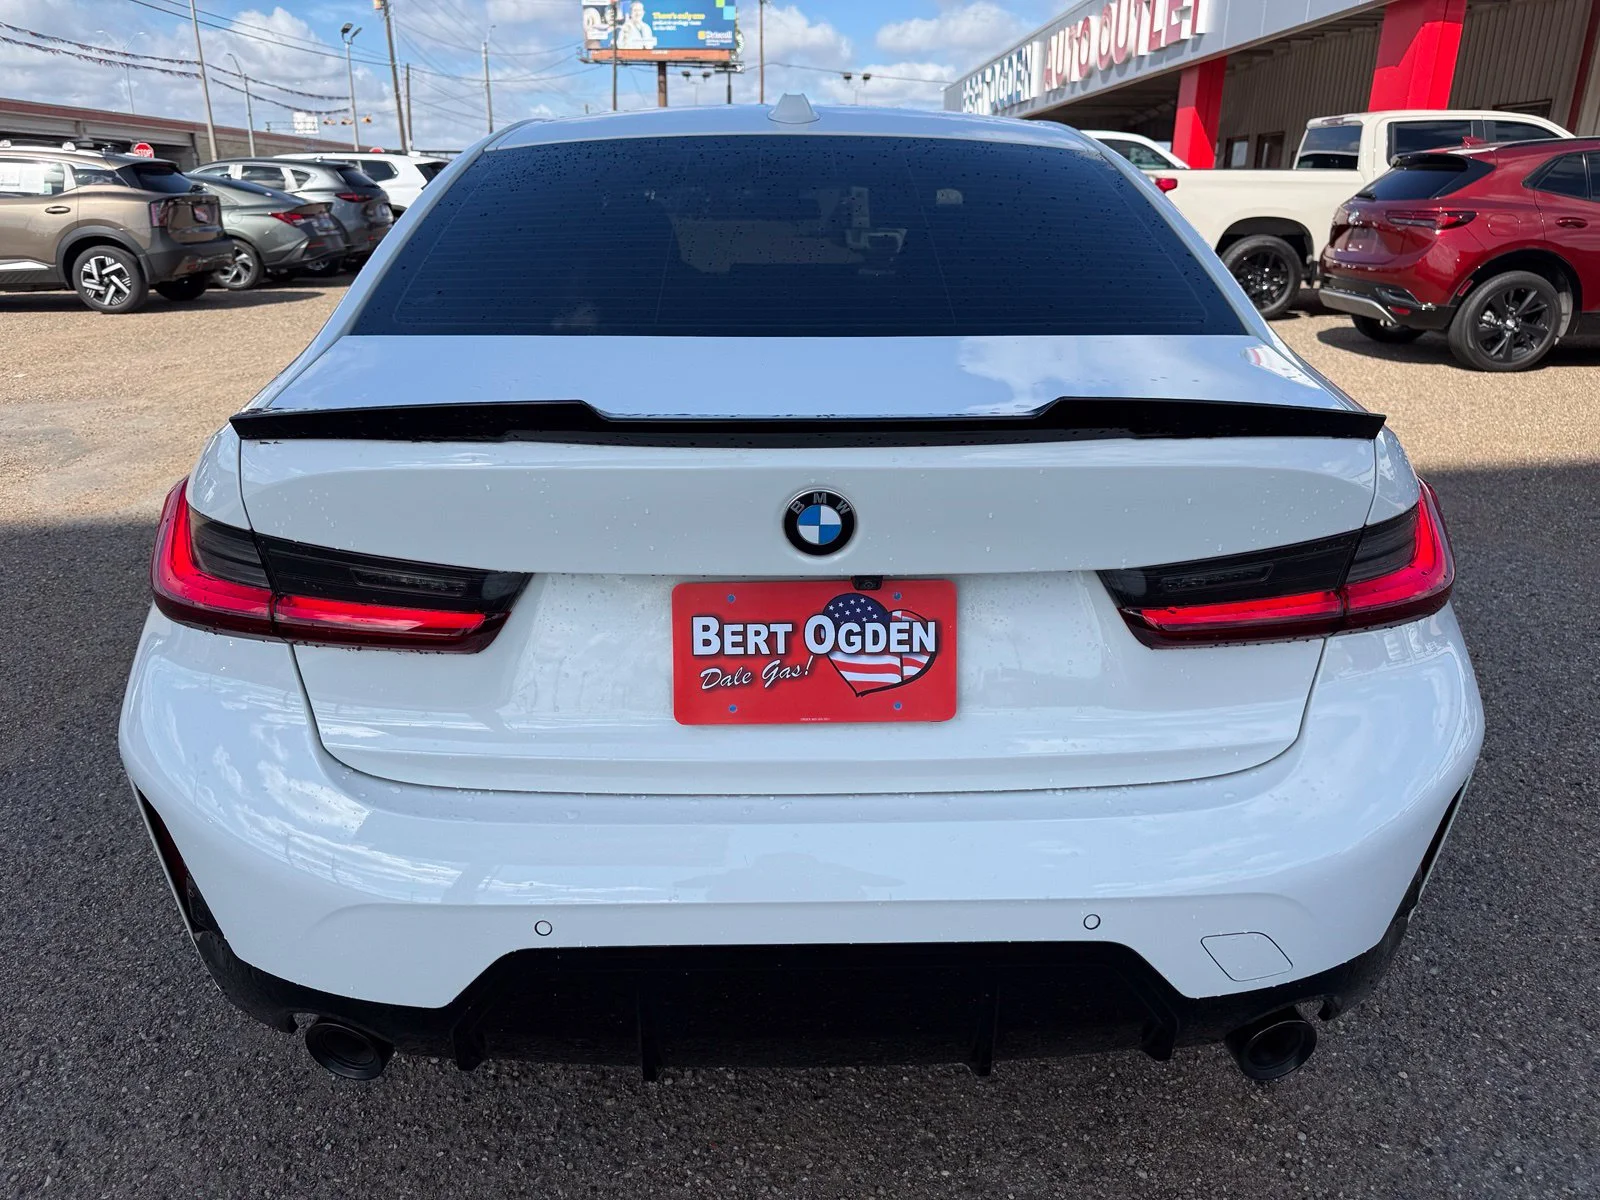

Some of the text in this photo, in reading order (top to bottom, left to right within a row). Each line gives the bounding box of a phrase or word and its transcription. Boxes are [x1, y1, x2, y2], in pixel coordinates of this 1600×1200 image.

[1044, 15, 1095, 91] AUTO
[790, 492, 850, 515] BMW
[692, 614, 936, 656] BERT OGDEN
[700, 655, 814, 690] Dale Gas!
